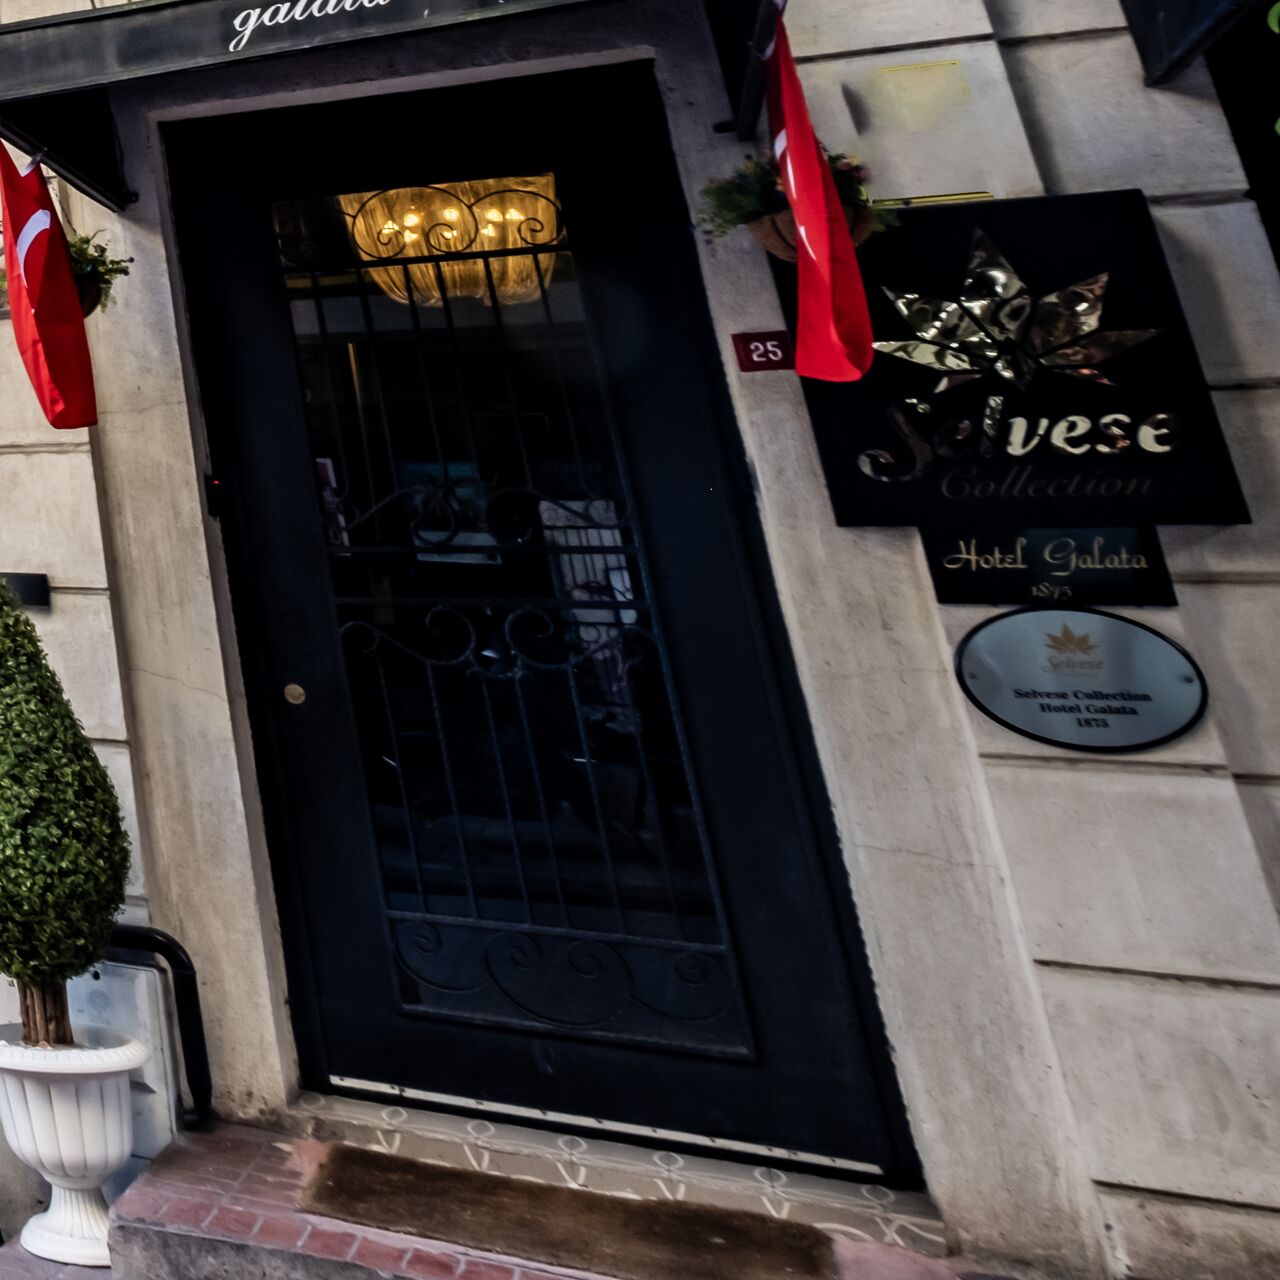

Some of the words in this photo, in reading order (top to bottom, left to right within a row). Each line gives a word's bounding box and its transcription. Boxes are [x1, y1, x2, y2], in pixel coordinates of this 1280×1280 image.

[749, 340, 783, 362] 25
[856, 395, 1178, 482] Selvese
[940, 463, 1156, 499] Collection
[943, 537, 1028, 572] Hotel
[1044, 537, 1149, 576] Galata
[1031, 582, 1073, 600] 1875
[1013, 688, 1068, 700] Selvese
[1073, 690, 1153, 702] Collection
[1040, 702, 1083, 714] Hotel
[1085, 704, 1139, 716] Galata
